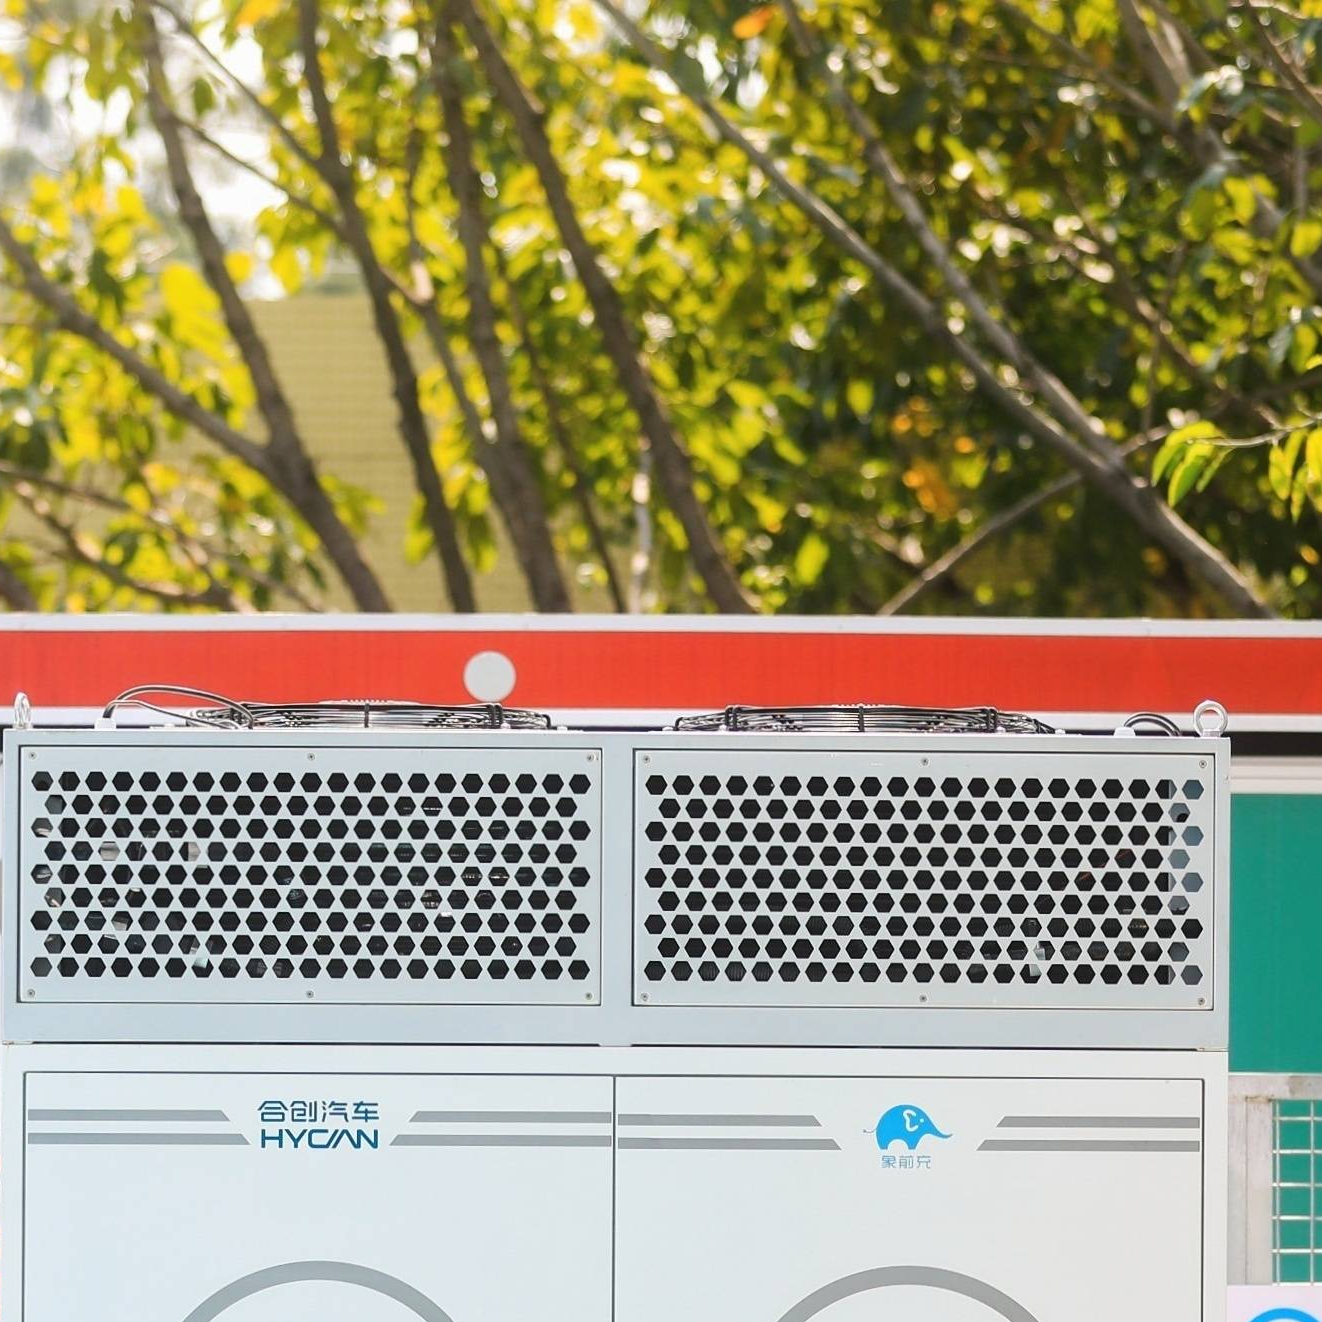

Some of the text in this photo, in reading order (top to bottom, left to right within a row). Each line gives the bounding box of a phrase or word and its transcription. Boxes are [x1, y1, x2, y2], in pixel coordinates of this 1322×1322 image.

[257, 1100, 380, 1123] 合创汽车
[260, 1128, 379, 1149] HYCAN
